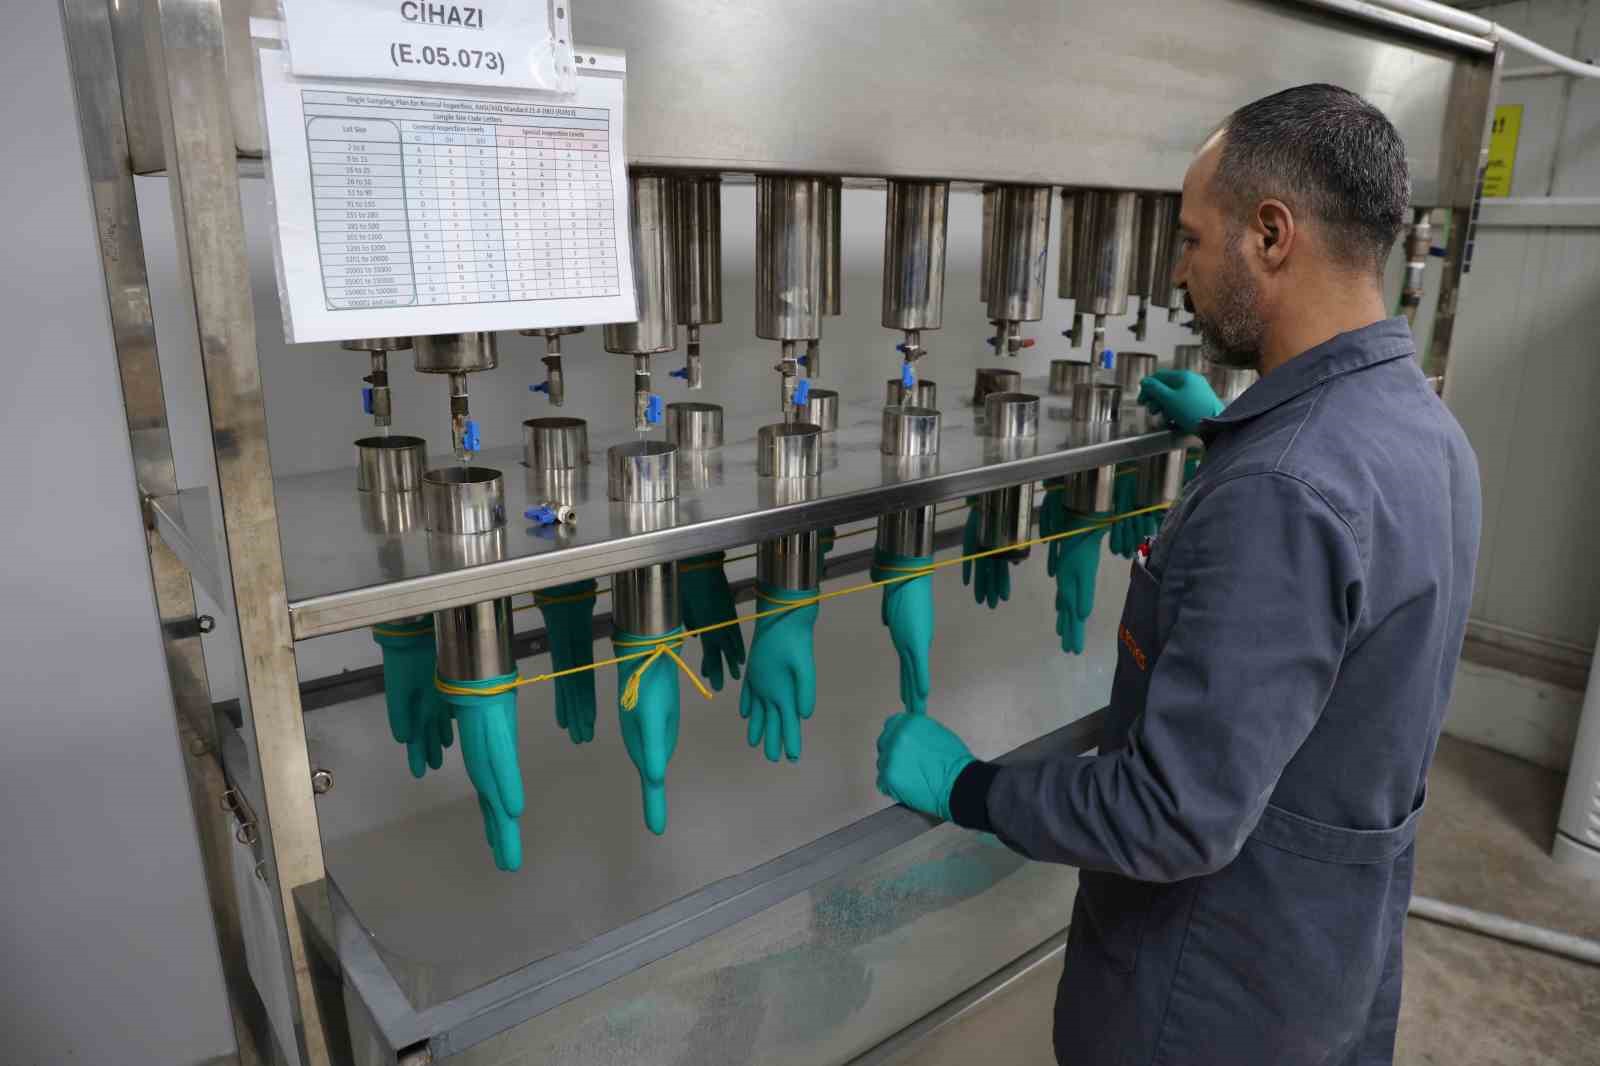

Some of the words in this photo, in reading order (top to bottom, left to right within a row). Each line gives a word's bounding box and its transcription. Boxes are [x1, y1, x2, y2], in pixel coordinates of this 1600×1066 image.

[401, 0, 483, 28] CİHAZI
[391, 43, 505, 75] (E.05.073)
[367, 97, 393, 107] Sampling
